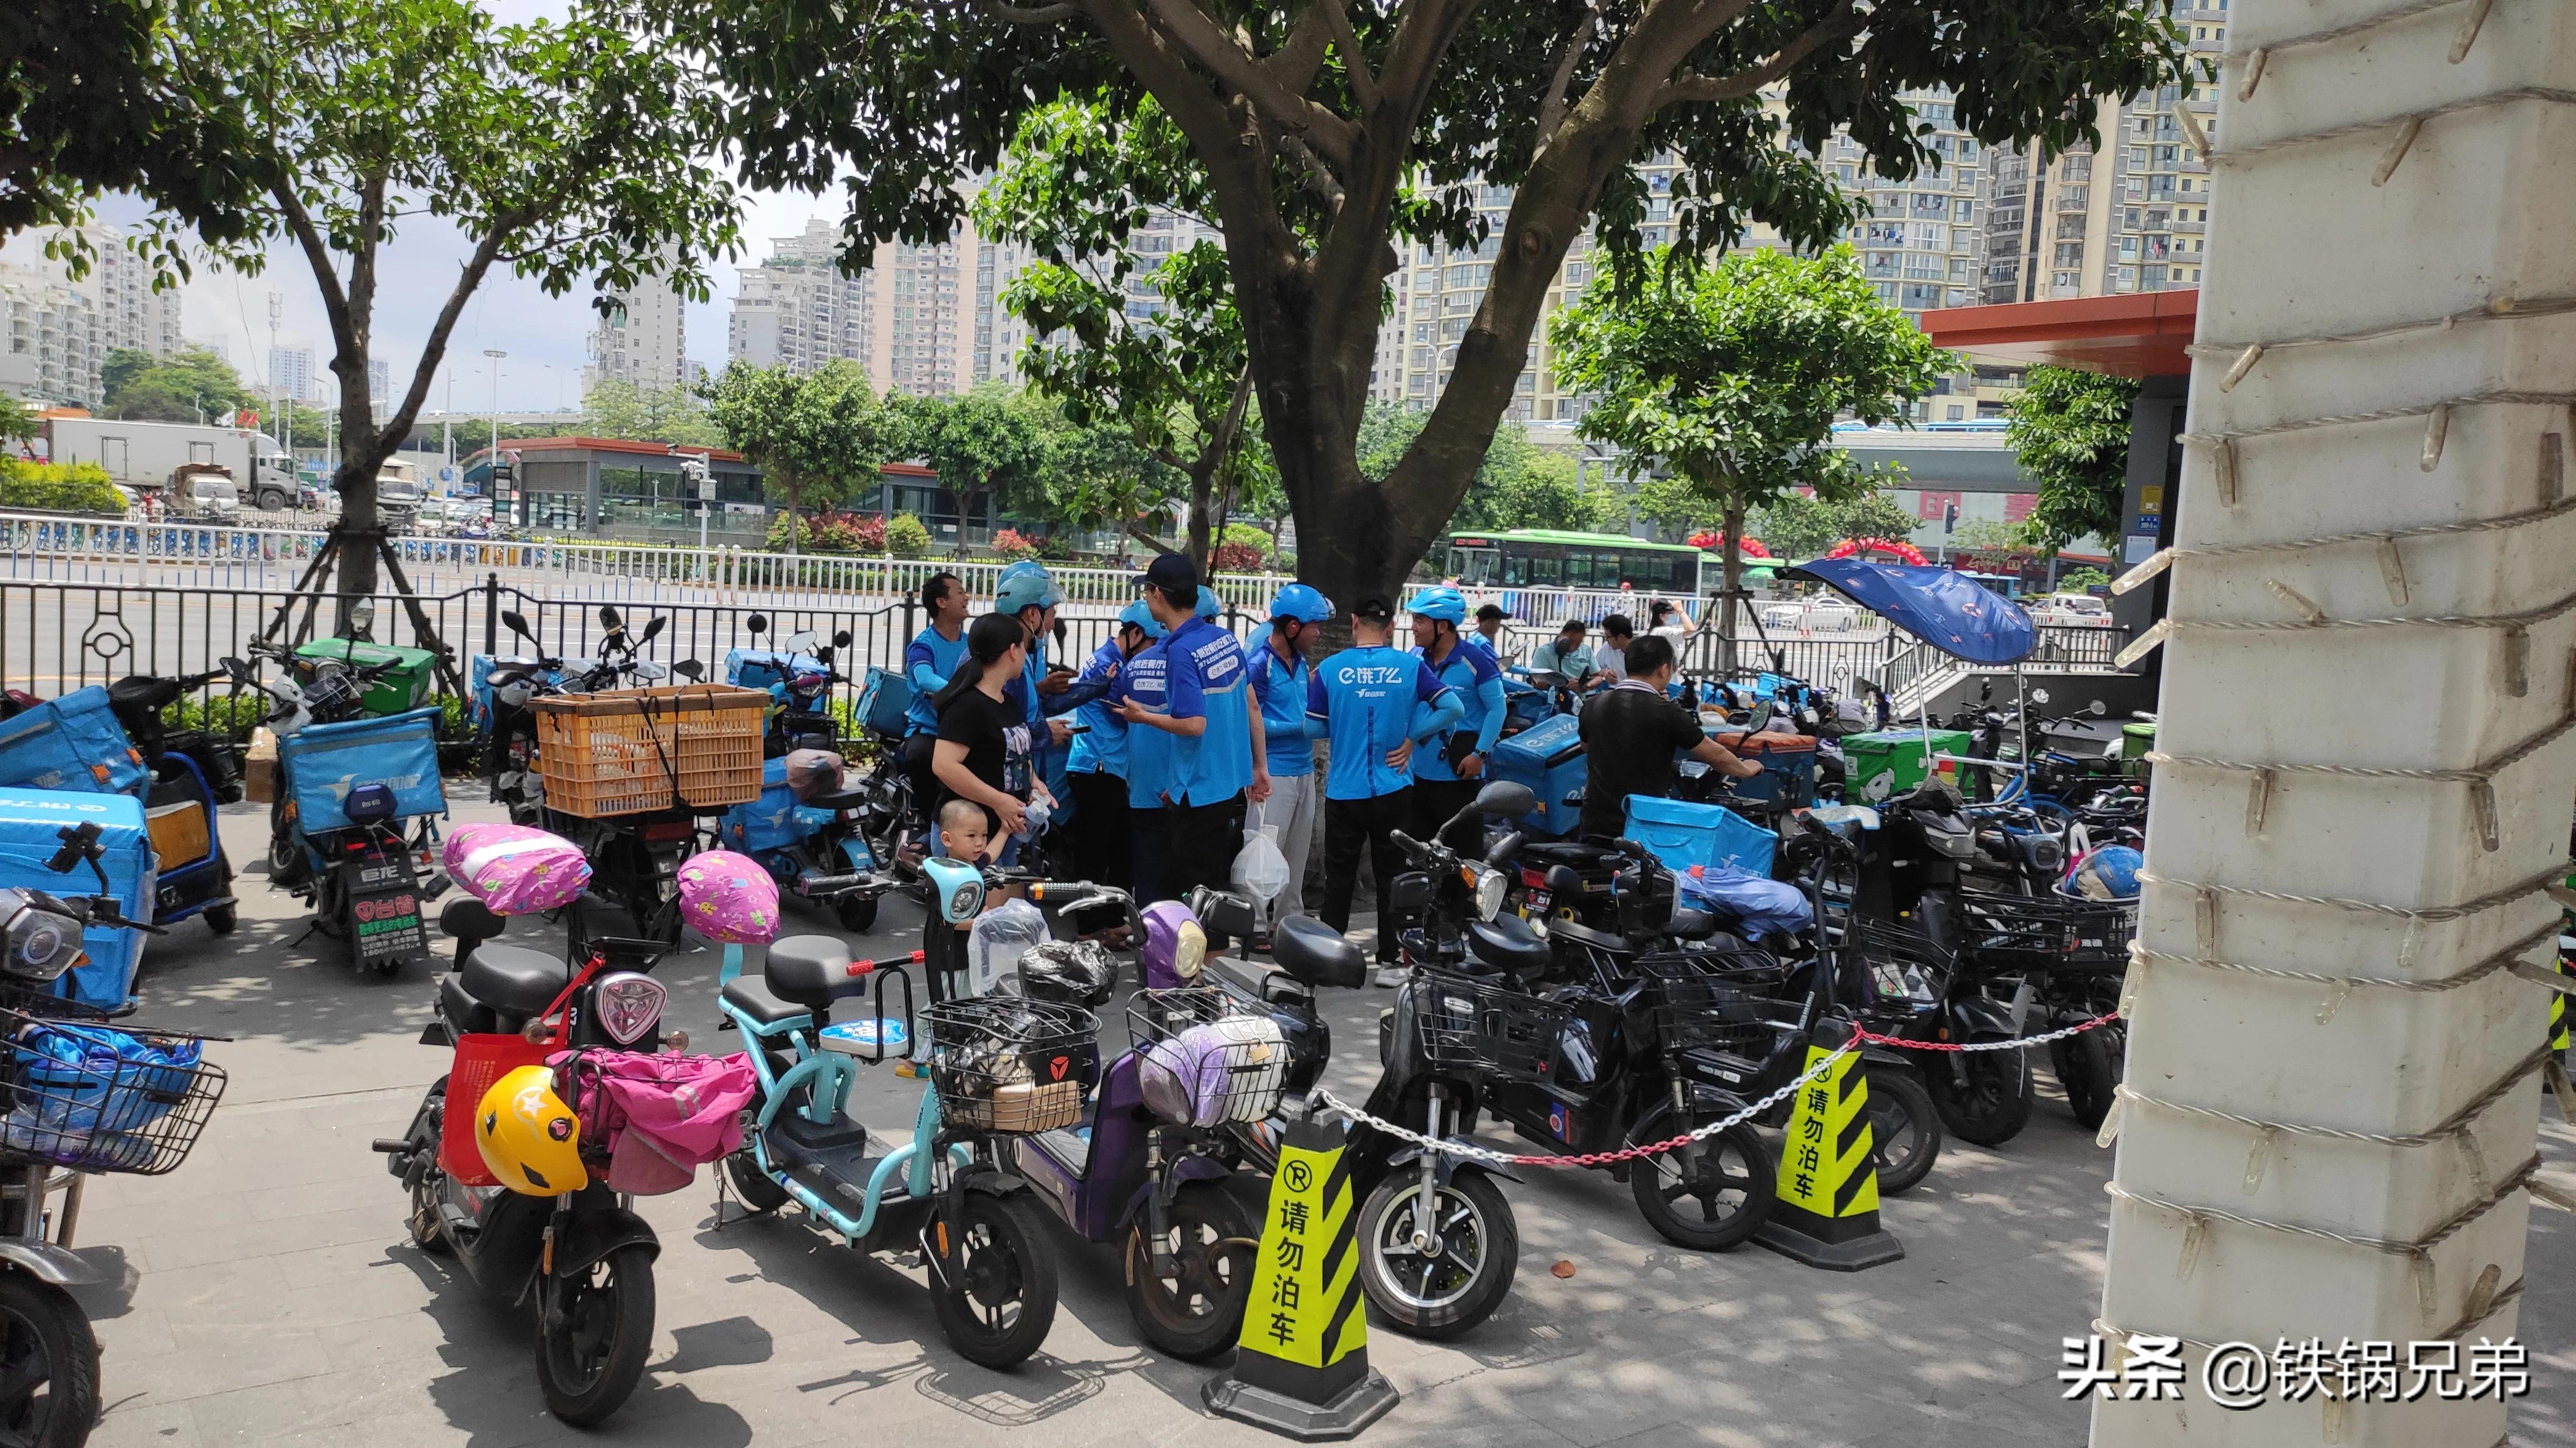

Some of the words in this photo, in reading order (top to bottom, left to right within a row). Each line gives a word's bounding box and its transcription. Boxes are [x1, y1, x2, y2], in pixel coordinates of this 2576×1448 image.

[1793, 1088, 1829, 1200] 请勿泊车
[1268, 1199, 1309, 1347] 请勿泊车
